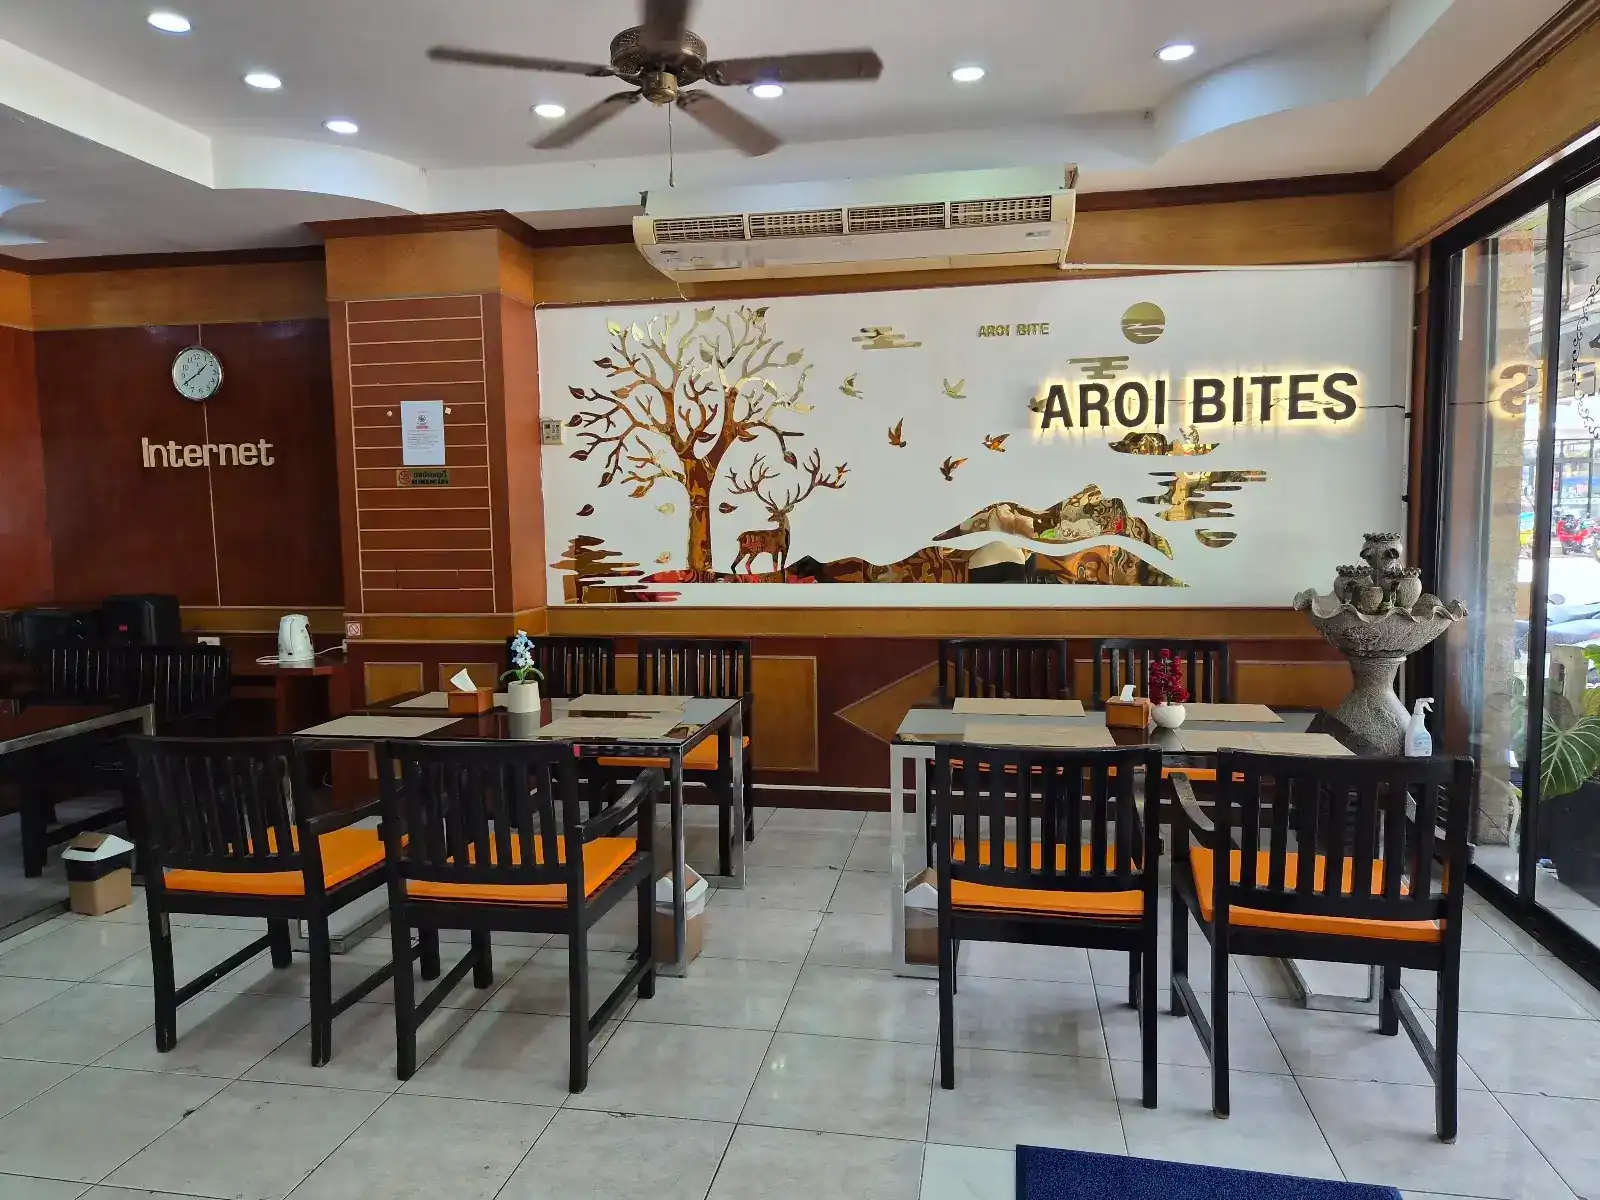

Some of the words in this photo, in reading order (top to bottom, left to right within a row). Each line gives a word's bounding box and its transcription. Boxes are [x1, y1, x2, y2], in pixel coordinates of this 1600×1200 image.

[978, 324, 1010, 337] AROI
[1017, 322, 1050, 336] BITE
[1041, 379, 1166, 429] AROI
[1192, 372, 1359, 425] BITES
[141, 437, 275, 468] Internet
